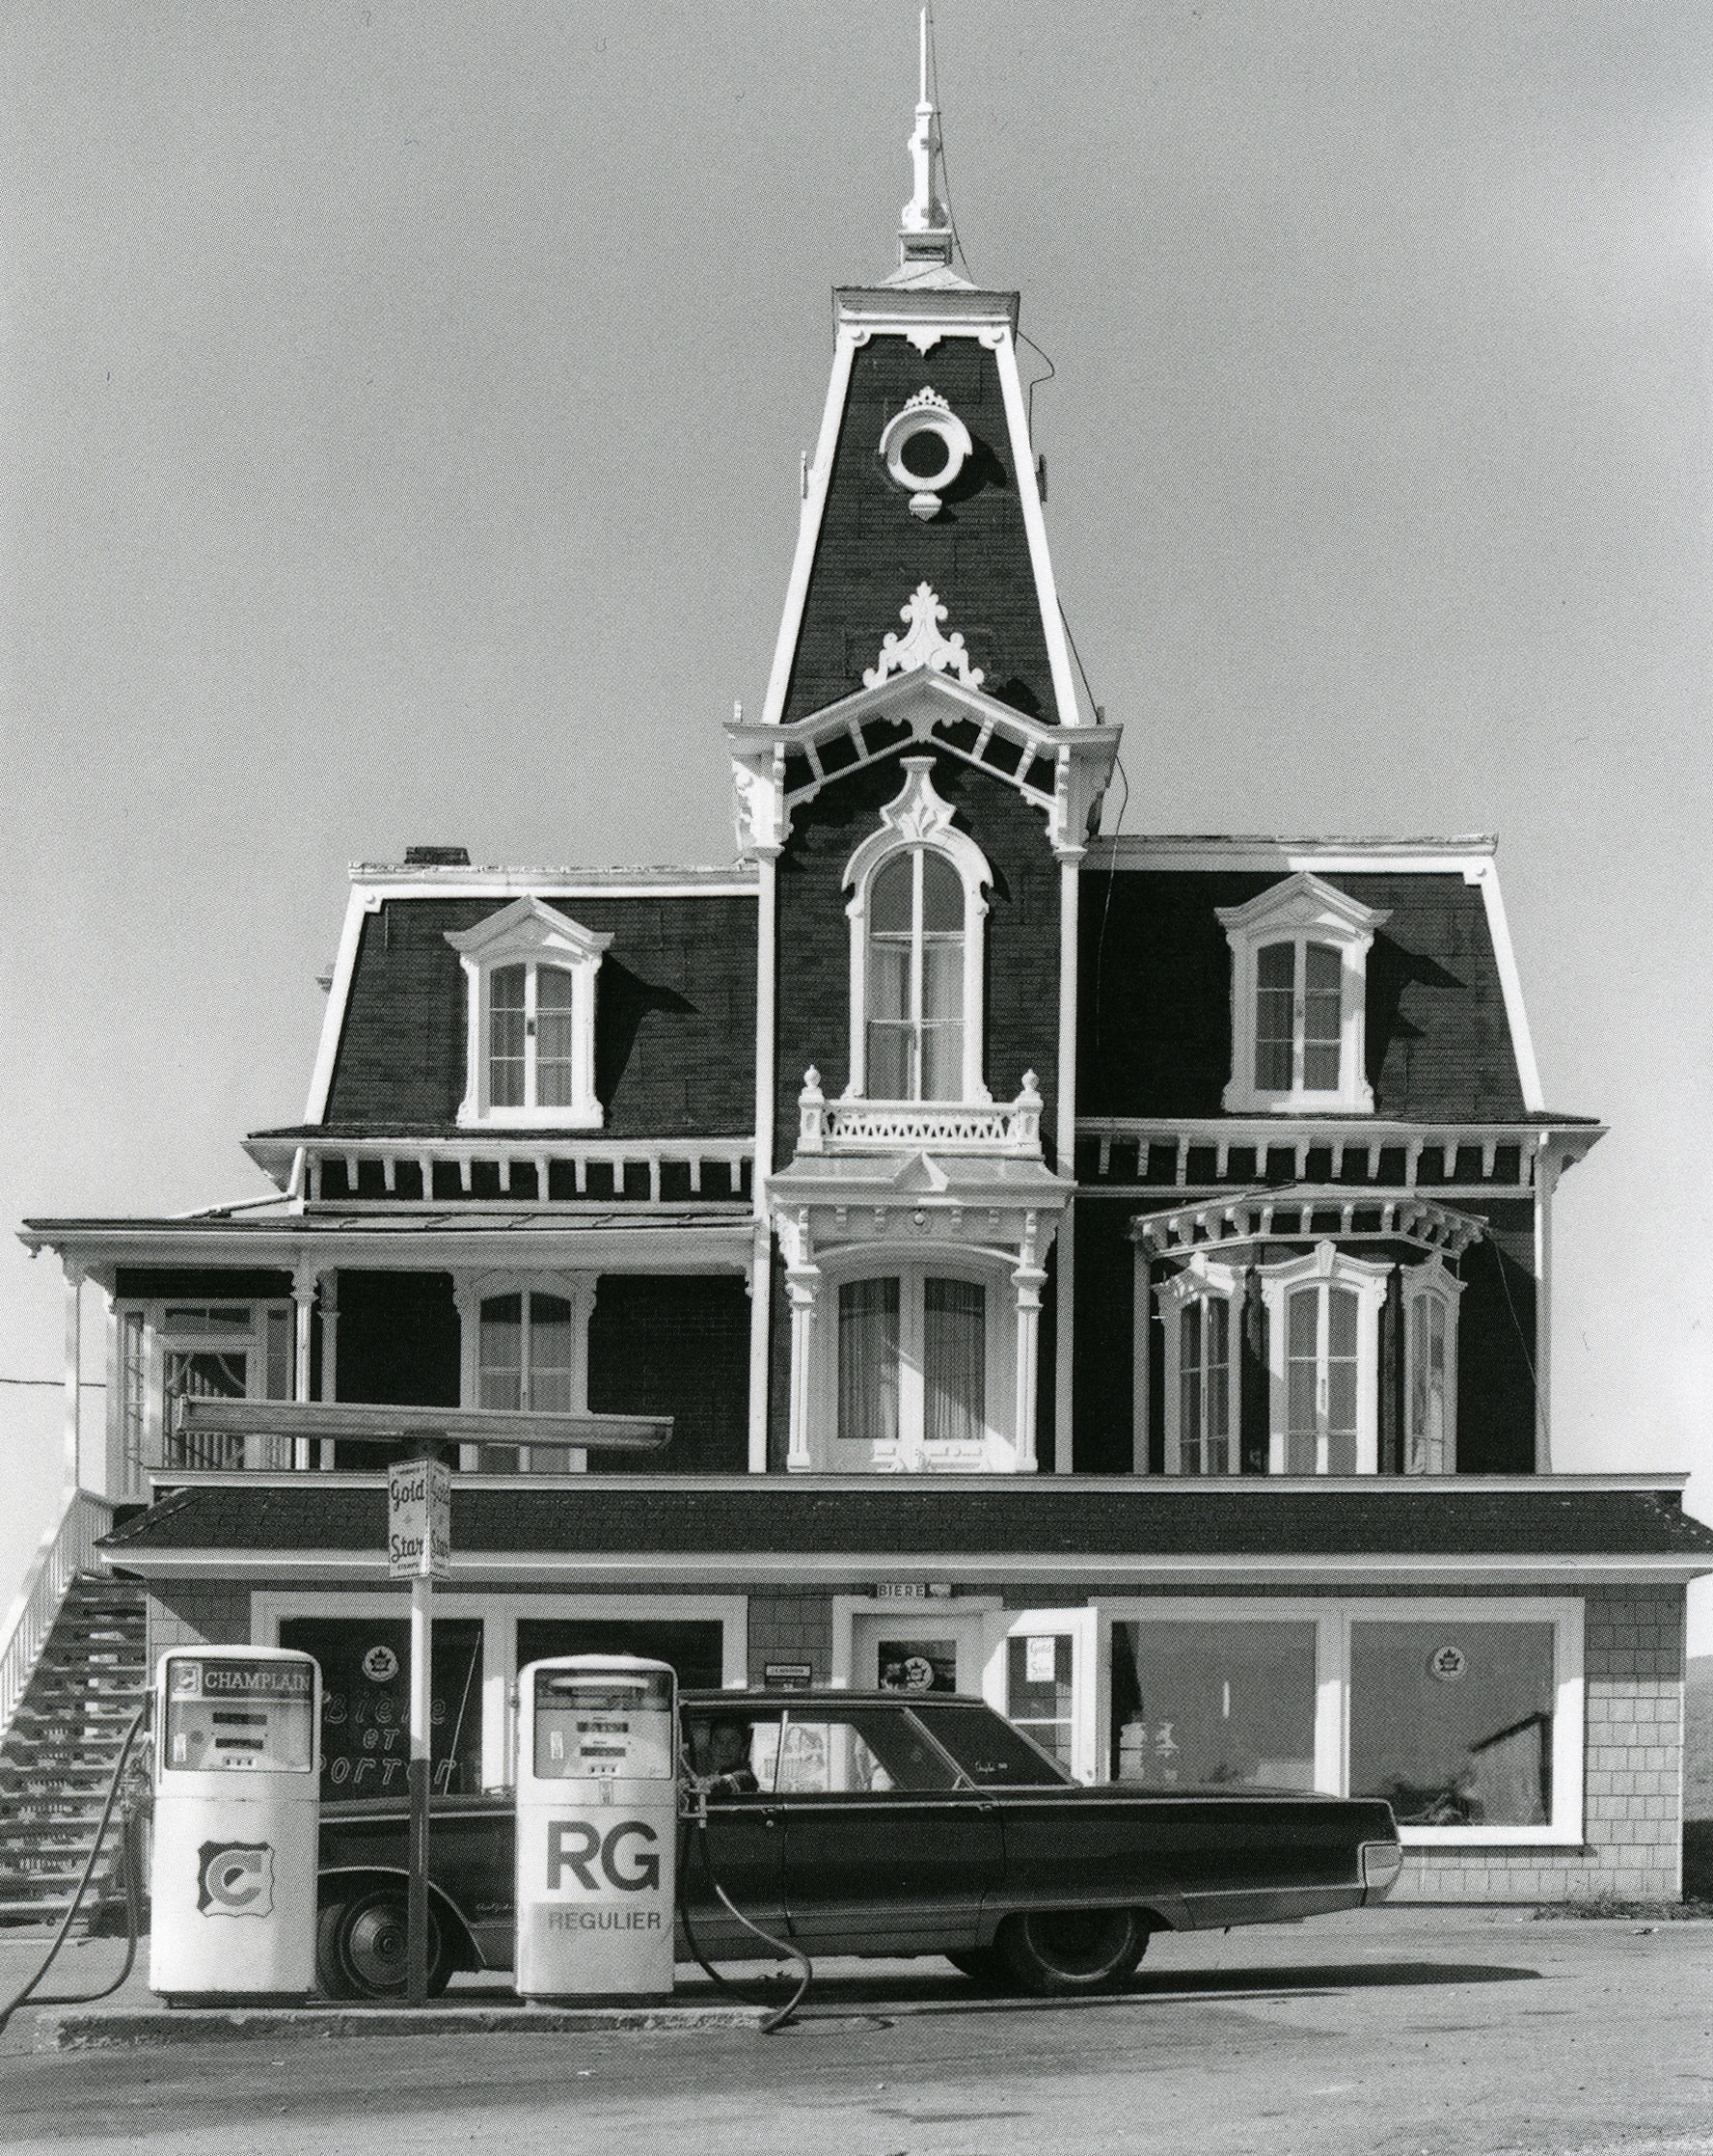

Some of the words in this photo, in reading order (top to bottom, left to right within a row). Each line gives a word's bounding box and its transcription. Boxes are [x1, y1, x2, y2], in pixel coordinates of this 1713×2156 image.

[391, 1479, 425, 1513] Gold
[391, 1534, 424, 1563] Star
[878, 1584, 924, 1597] BIERE
[1029, 1640, 1052, 1657] Gold
[204, 1672, 311, 1690] CHAMPLAIN
[547, 1820, 661, 1892] RG
[548, 1912, 662, 1930] REGULIER
